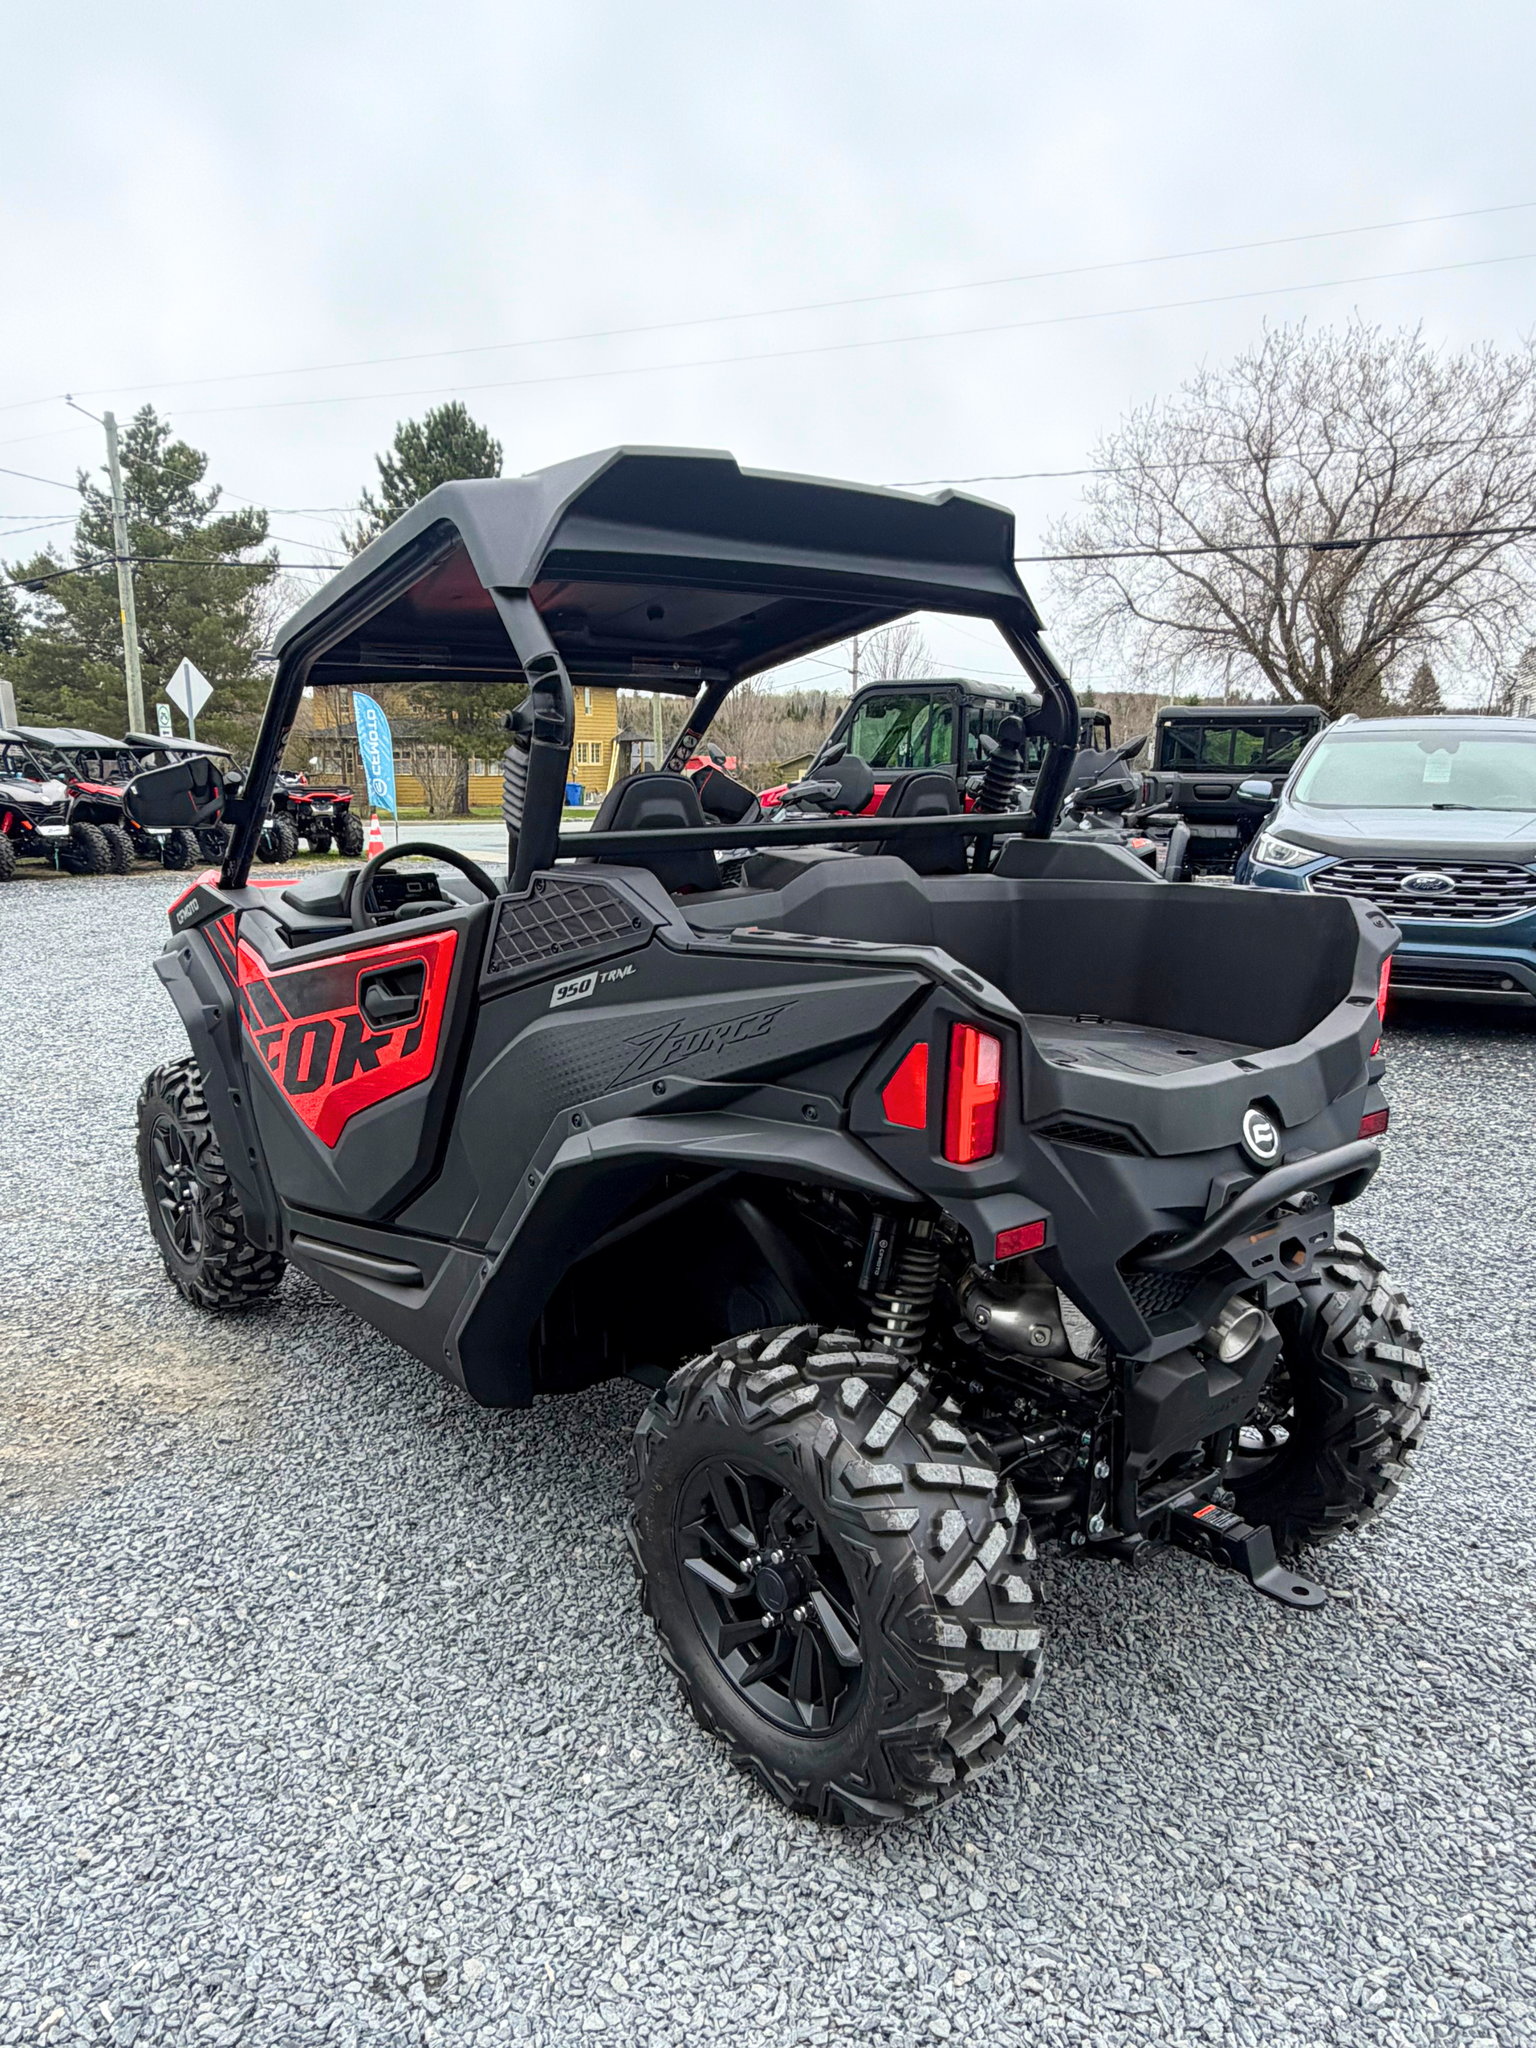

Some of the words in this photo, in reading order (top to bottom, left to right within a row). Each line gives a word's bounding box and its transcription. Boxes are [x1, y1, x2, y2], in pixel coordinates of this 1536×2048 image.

[176, 897, 200, 925] CFMOTO
[556, 978, 593, 1001] 950
[599, 963, 637, 984] TRAIL
